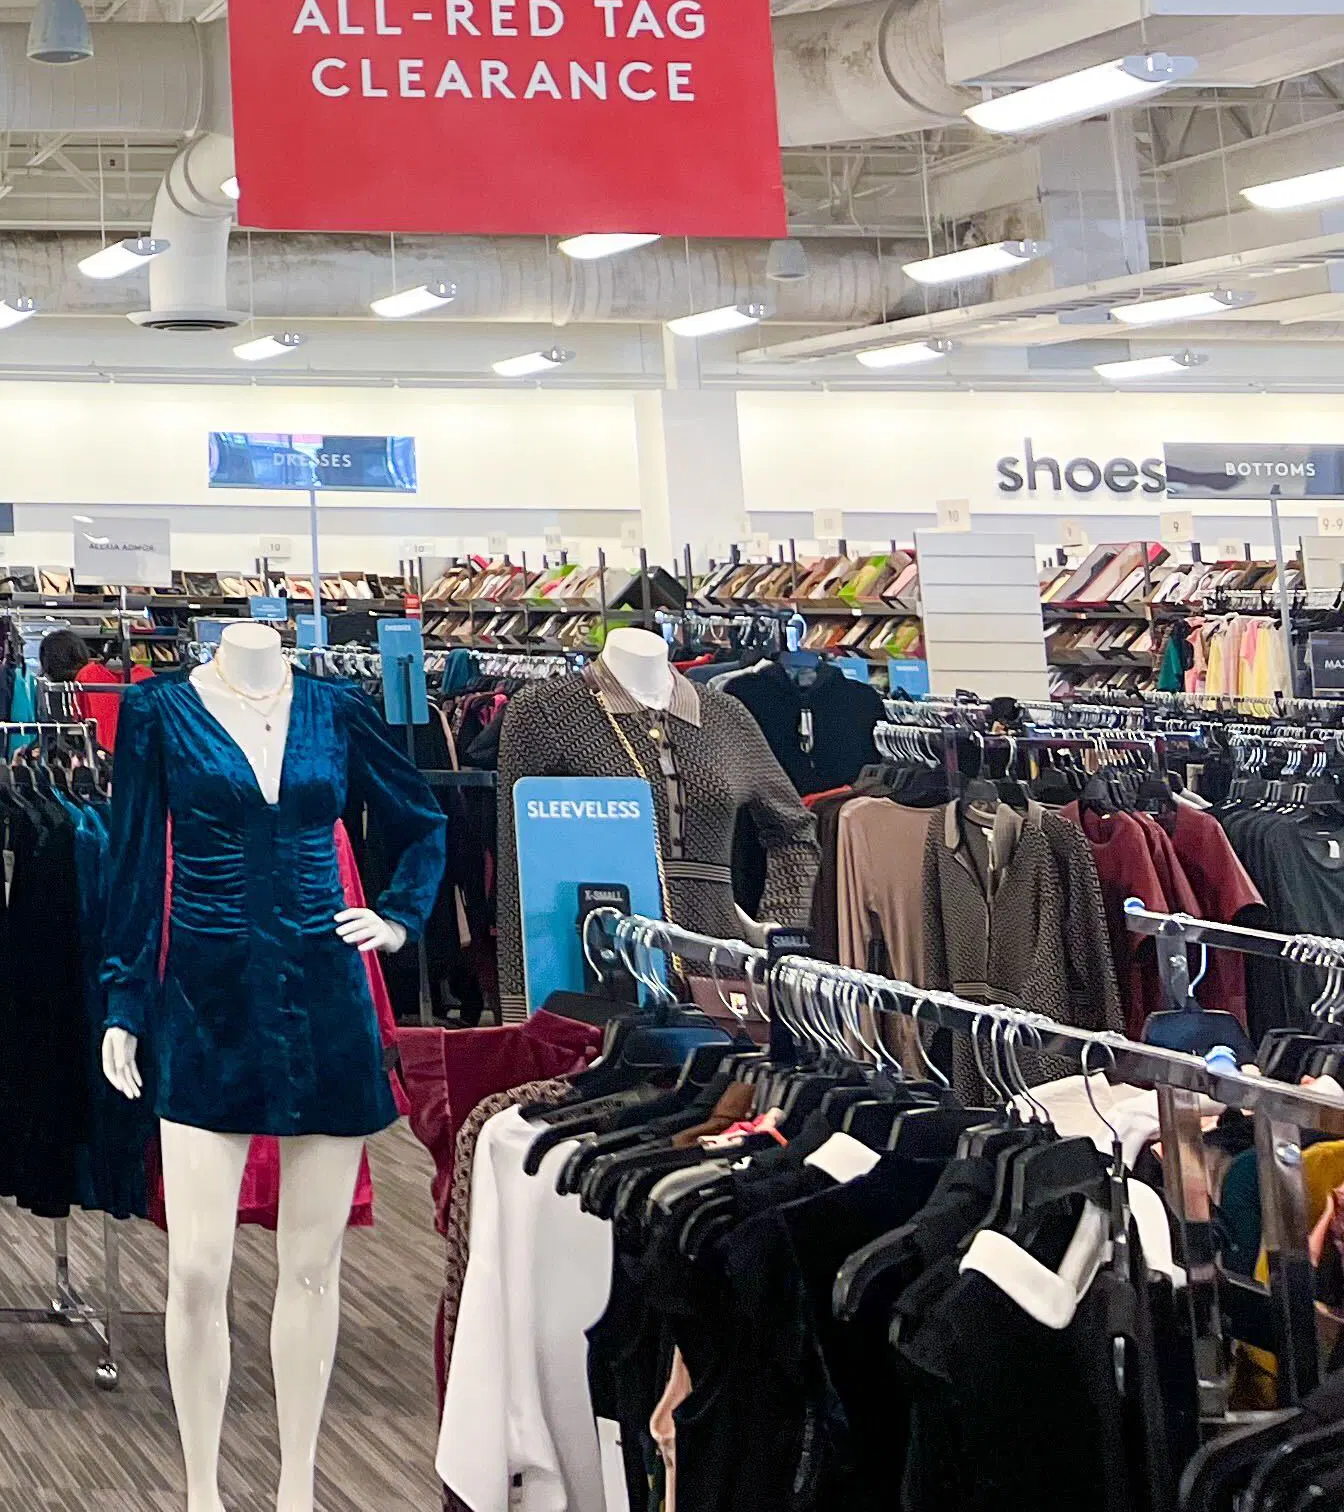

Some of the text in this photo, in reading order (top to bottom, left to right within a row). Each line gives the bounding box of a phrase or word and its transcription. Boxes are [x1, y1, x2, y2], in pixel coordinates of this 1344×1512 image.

[594, 0, 706, 39] TAG
[312, 57, 695, 102] CLEARANCE
[997, 437, 1166, 493] shoes
[1225, 462, 1316, 477] BOTTOMS
[947, 510, 960, 522] 10
[527, 800, 641, 819] SLEEVELESS
